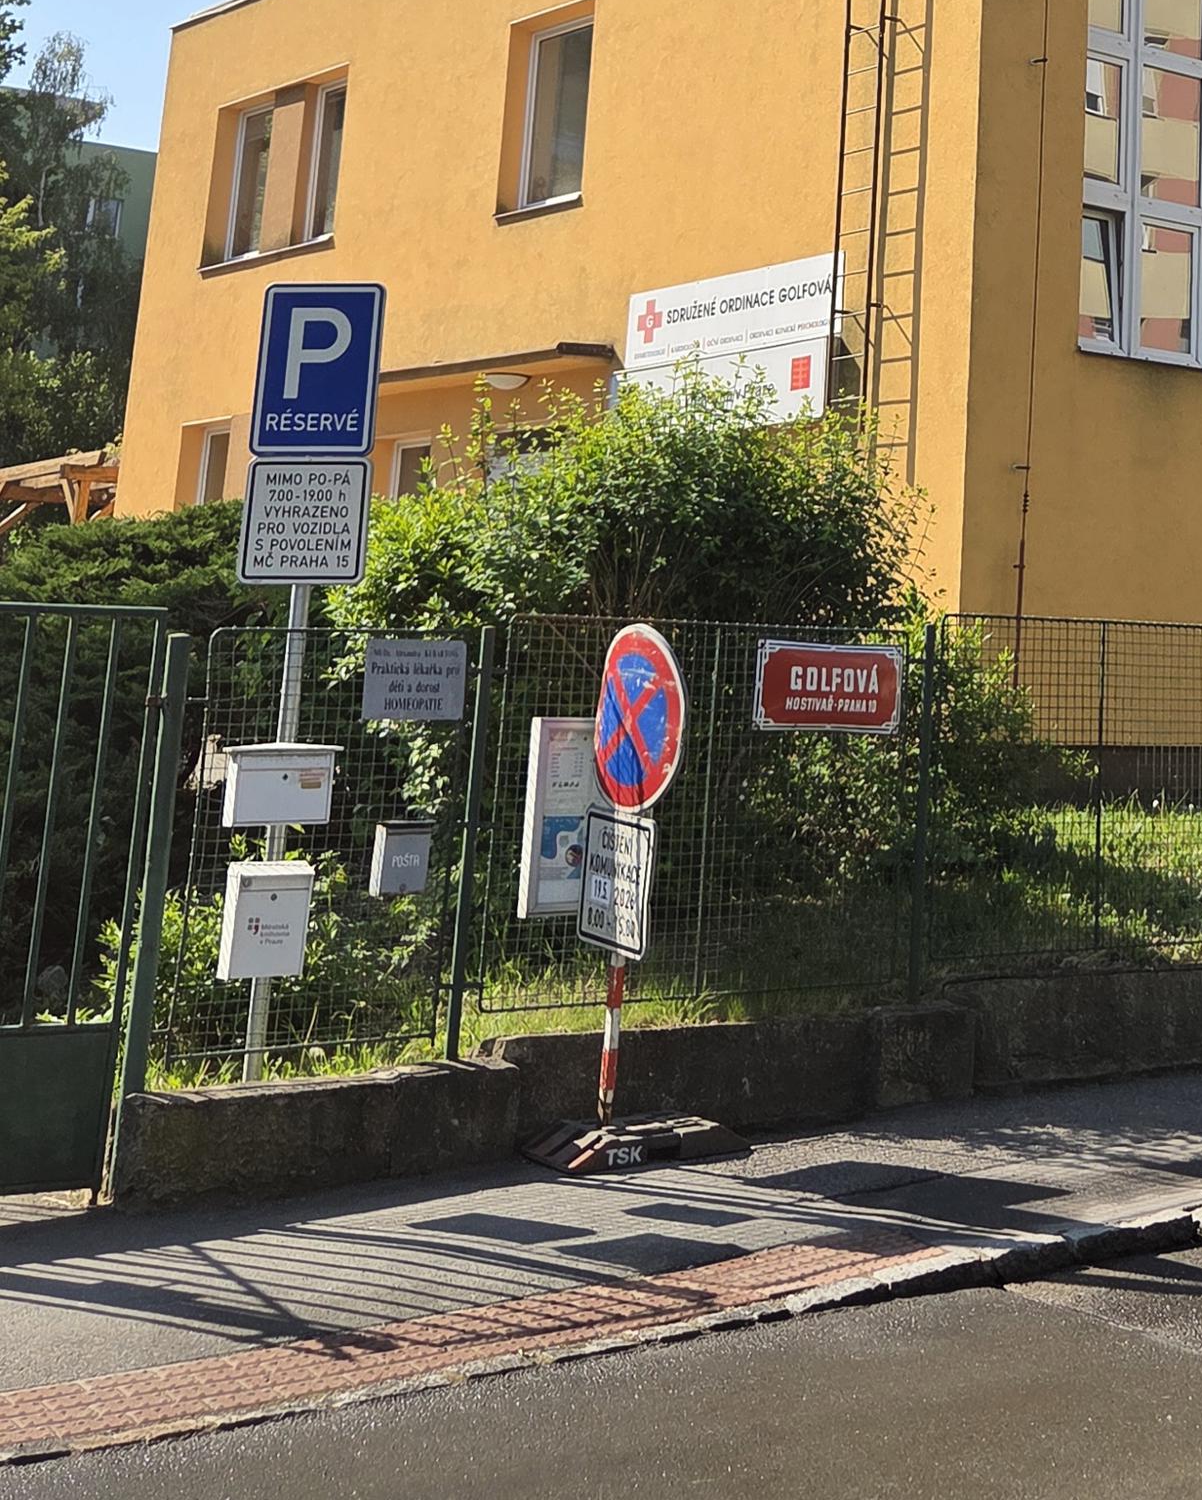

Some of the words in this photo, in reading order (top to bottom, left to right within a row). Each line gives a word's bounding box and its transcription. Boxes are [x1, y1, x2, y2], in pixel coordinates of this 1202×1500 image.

[666, 296, 717, 325] SDRUŽENÉ
[719, 290, 775, 314] ORDINACE
[778, 274, 833, 303] GOLFOVÁ
[645, 315, 654, 328] G
[283, 307, 352, 399] P
[265, 408, 360, 431] RÉSERVÉ
[266, 473, 302, 486] MIMO
[308, 470, 351, 486] PO-PÁ
[338, 489, 346, 502] h
[264, 505, 349, 519] VYHRAZENO
[257, 522, 285, 535] PRO
[292, 522, 350, 535] VOZIDLA
[255, 539, 264, 551] S
[270, 535, 352, 551] POVOLENÍM
[253, 553, 275, 568] MČ
[280, 555, 330, 568] PRAHA
[336, 555, 349, 568] 15
[445, 665, 460, 679] pro
[790, 663, 879, 695] GOLFOVÁ
[388, 680, 405, 693] děti
[407, 684, 412, 693] a
[415, 680, 440, 693] dorost
[384, 697, 444, 711] HOMEOPATIE
[868, 699, 877, 713] 10
[391, 852, 420, 868] POŠTA
[606, 1145, 643, 1167] TSK
